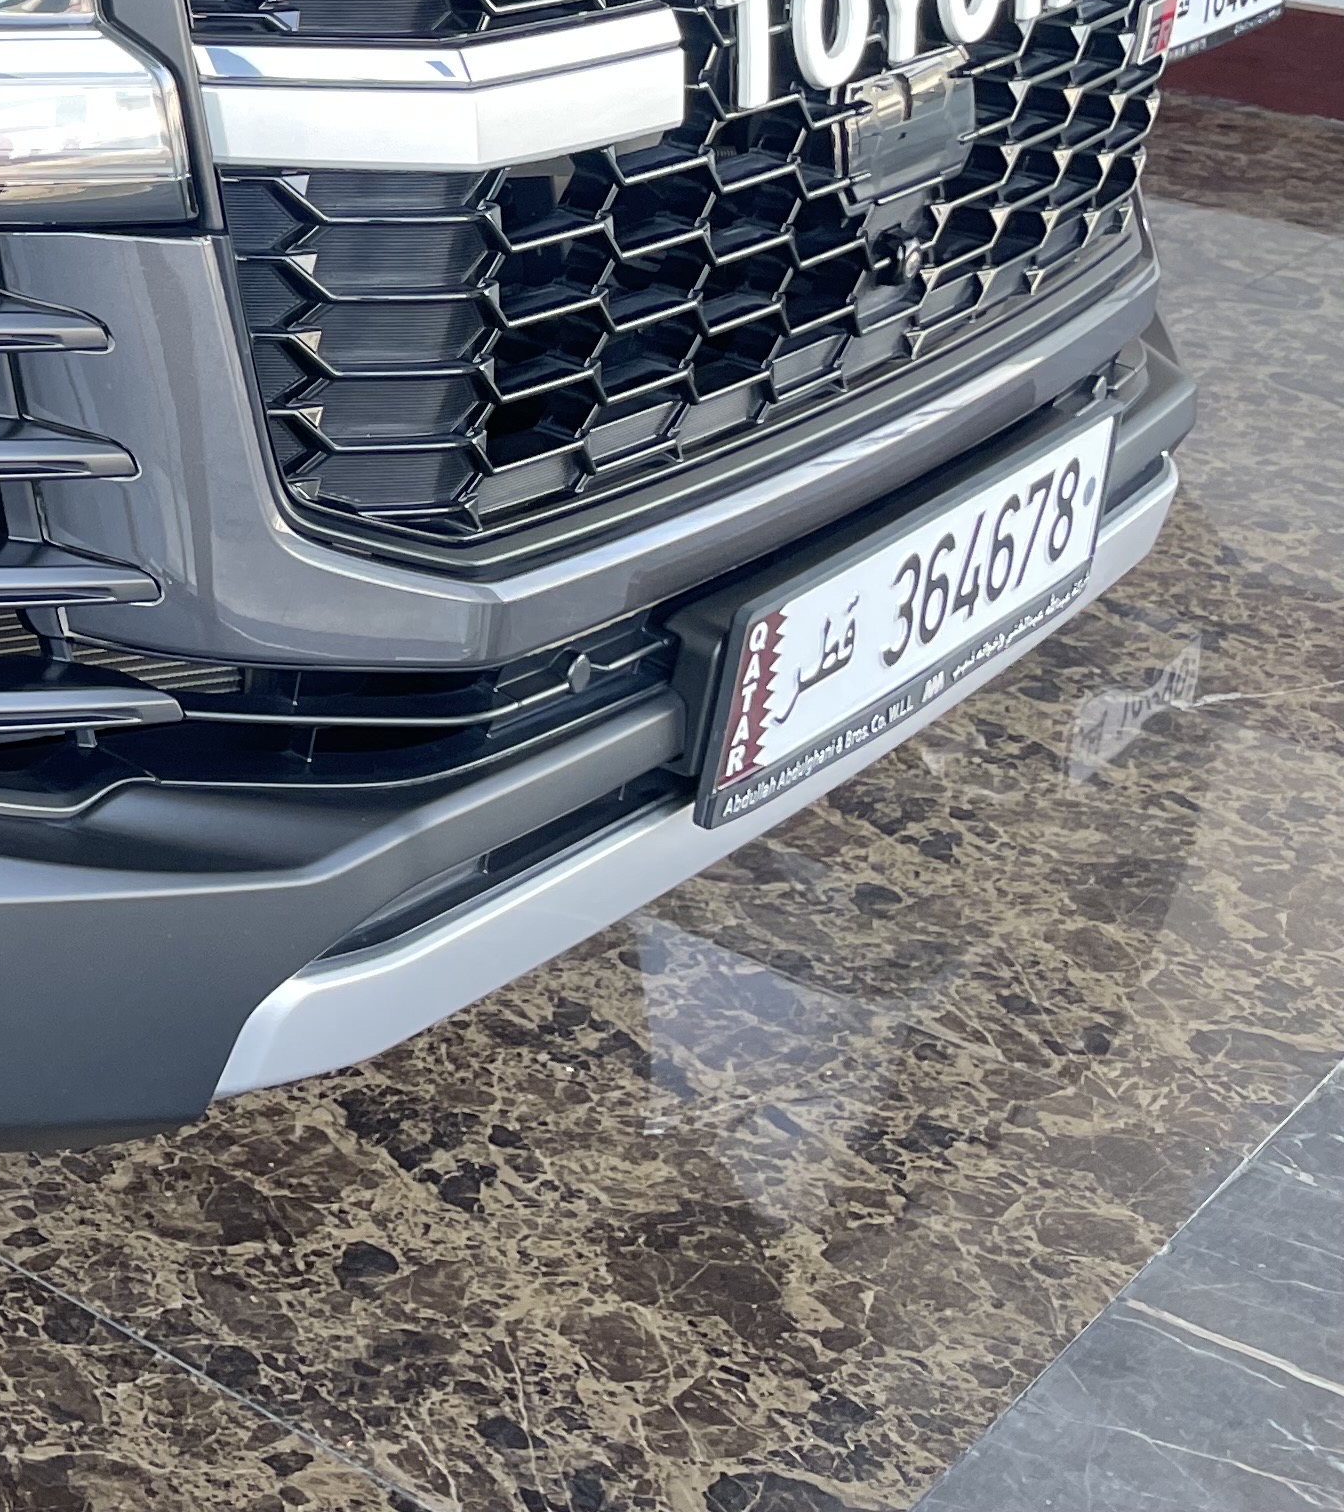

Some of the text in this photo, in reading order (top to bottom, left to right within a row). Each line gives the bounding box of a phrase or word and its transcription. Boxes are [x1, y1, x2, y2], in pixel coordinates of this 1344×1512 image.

[879, 457, 1081, 668] 364678
[725, 621, 769, 777] QATAR
[773, 592, 861, 724] قطر
[722, 776, 777, 818] Abdullah
